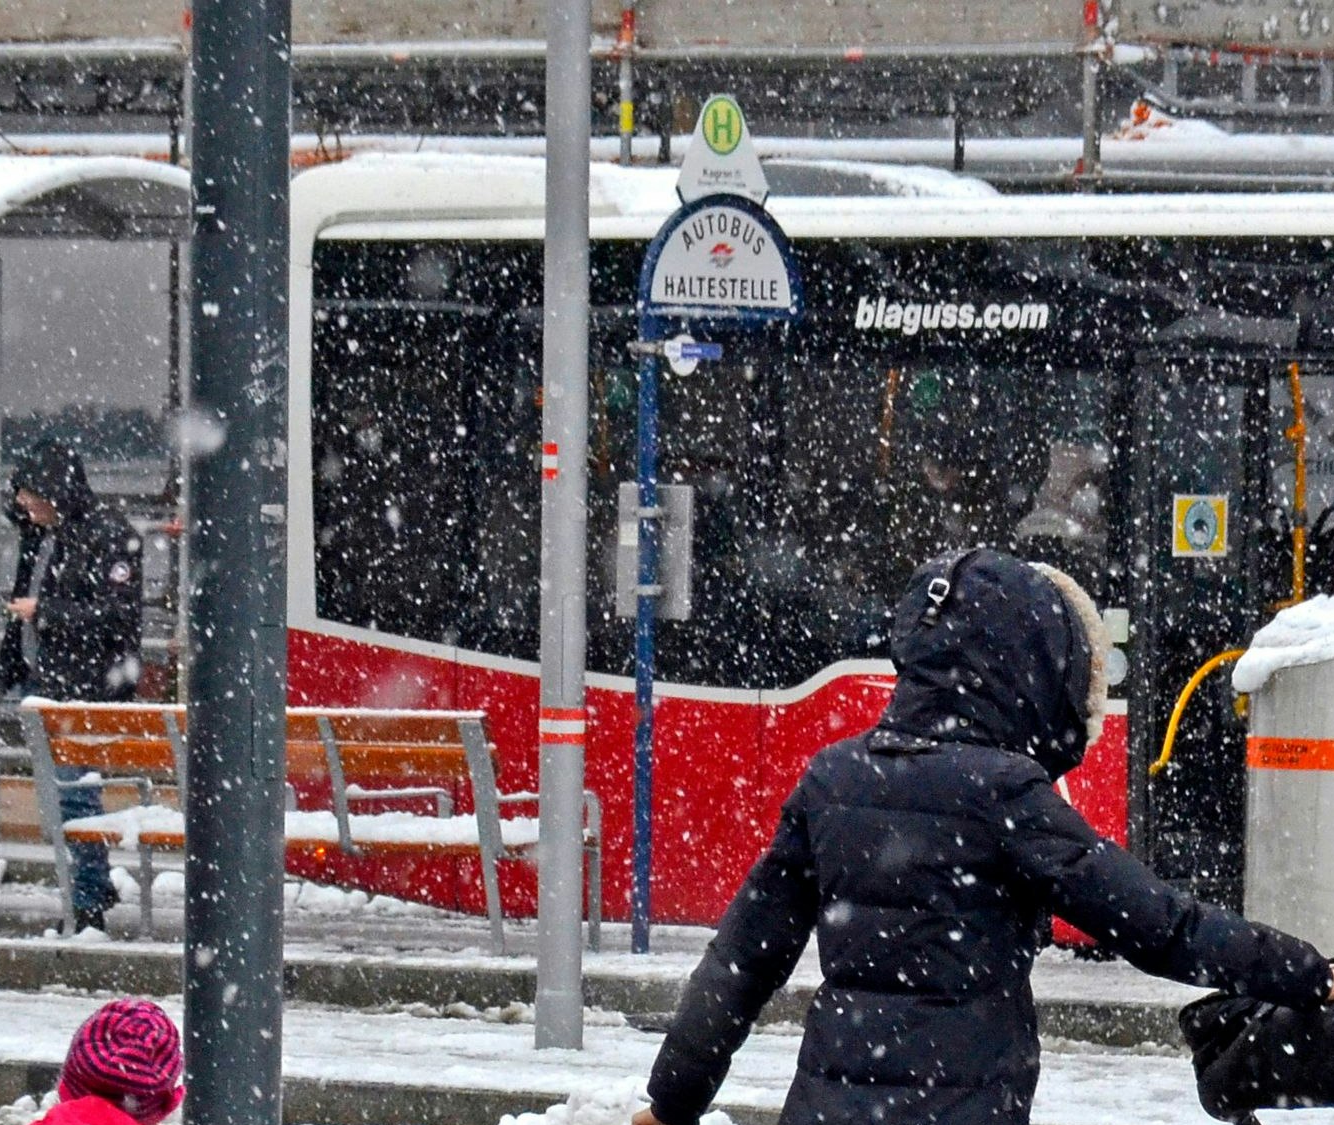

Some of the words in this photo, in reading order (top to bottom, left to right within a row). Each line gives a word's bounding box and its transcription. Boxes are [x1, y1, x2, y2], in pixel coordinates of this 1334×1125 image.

[712, 108, 733, 144] H
[681, 213, 766, 255] AUTOBUS
[664, 275, 779, 301] HALTESTELLE
[854, 295, 1050, 336] blaguss.com
